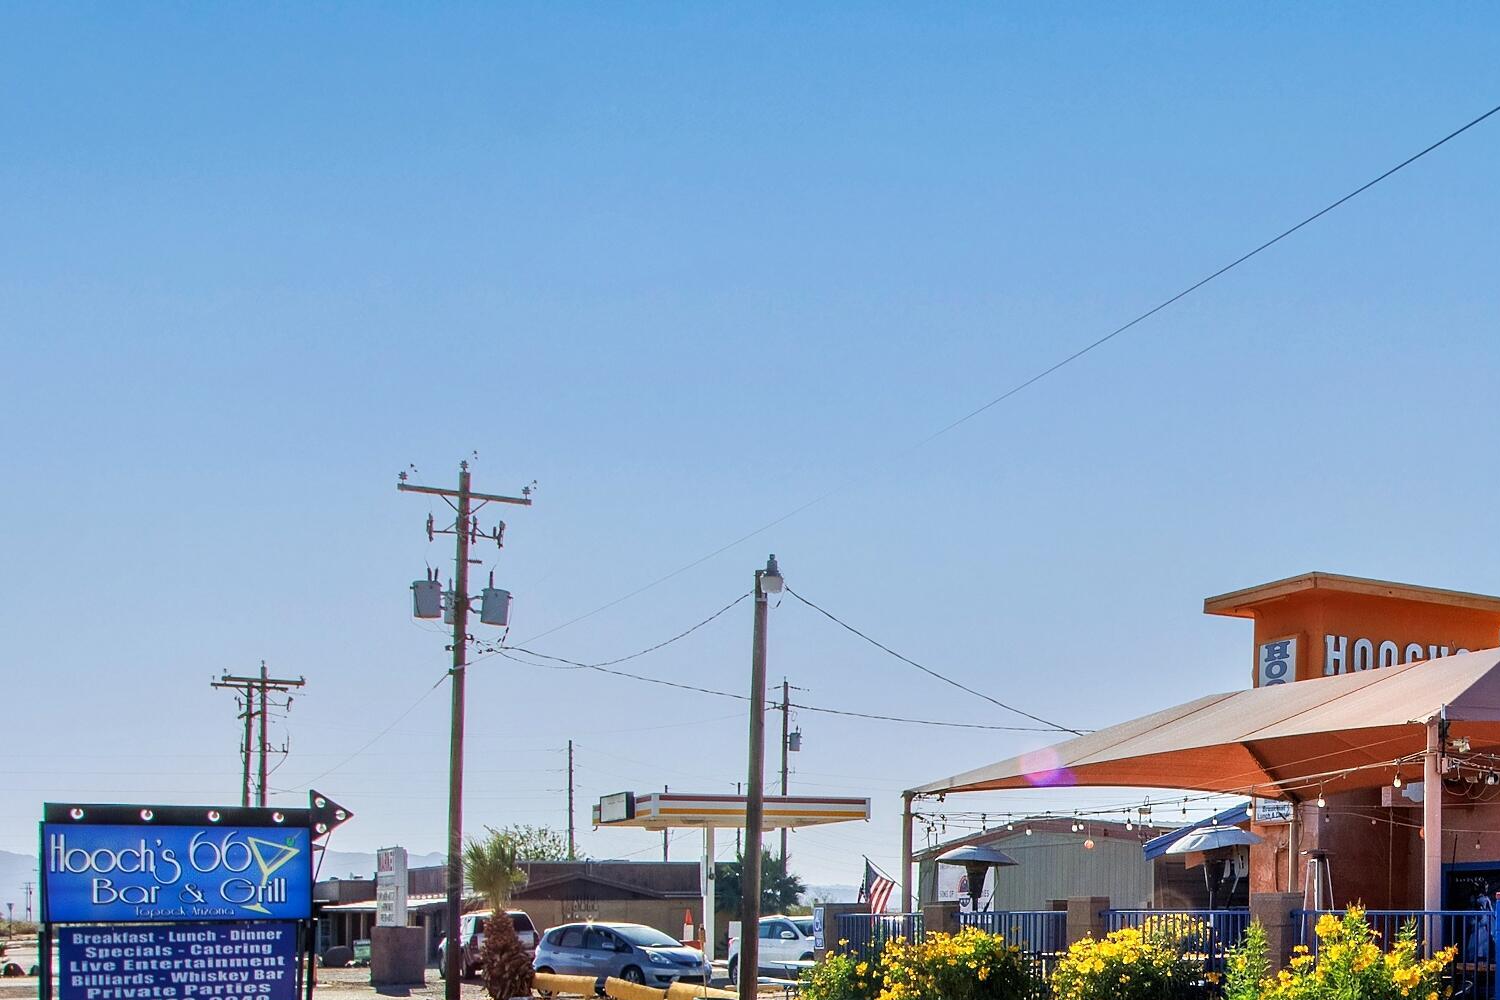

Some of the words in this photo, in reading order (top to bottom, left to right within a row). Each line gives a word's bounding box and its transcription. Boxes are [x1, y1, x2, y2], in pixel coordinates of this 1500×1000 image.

[50, 833, 183, 884] Hooch's
[189, 831, 253, 872] 66
[92, 878, 161, 904] Bar
[179, 884, 206, 904] &
[220, 878, 287, 904] Grill
[191, 906, 235, 916] Arizona
[72, 932, 155, 945] Breakfast
[168, 930, 217, 943] Lunch
[230, 929, 283, 941] Dinner
[85, 945, 173, 959] Specials
[190, 943, 273, 956] Catering
[70, 960, 117, 973] Live
[123, 955, 286, 971] Entertainment
[71, 973, 155, 987] Billiards
[171, 970, 249, 984] Whiskey
[253, 969, 285, 981] Bar
[87, 985, 177, 999] Private
[184, 983, 272, 996] Parties
